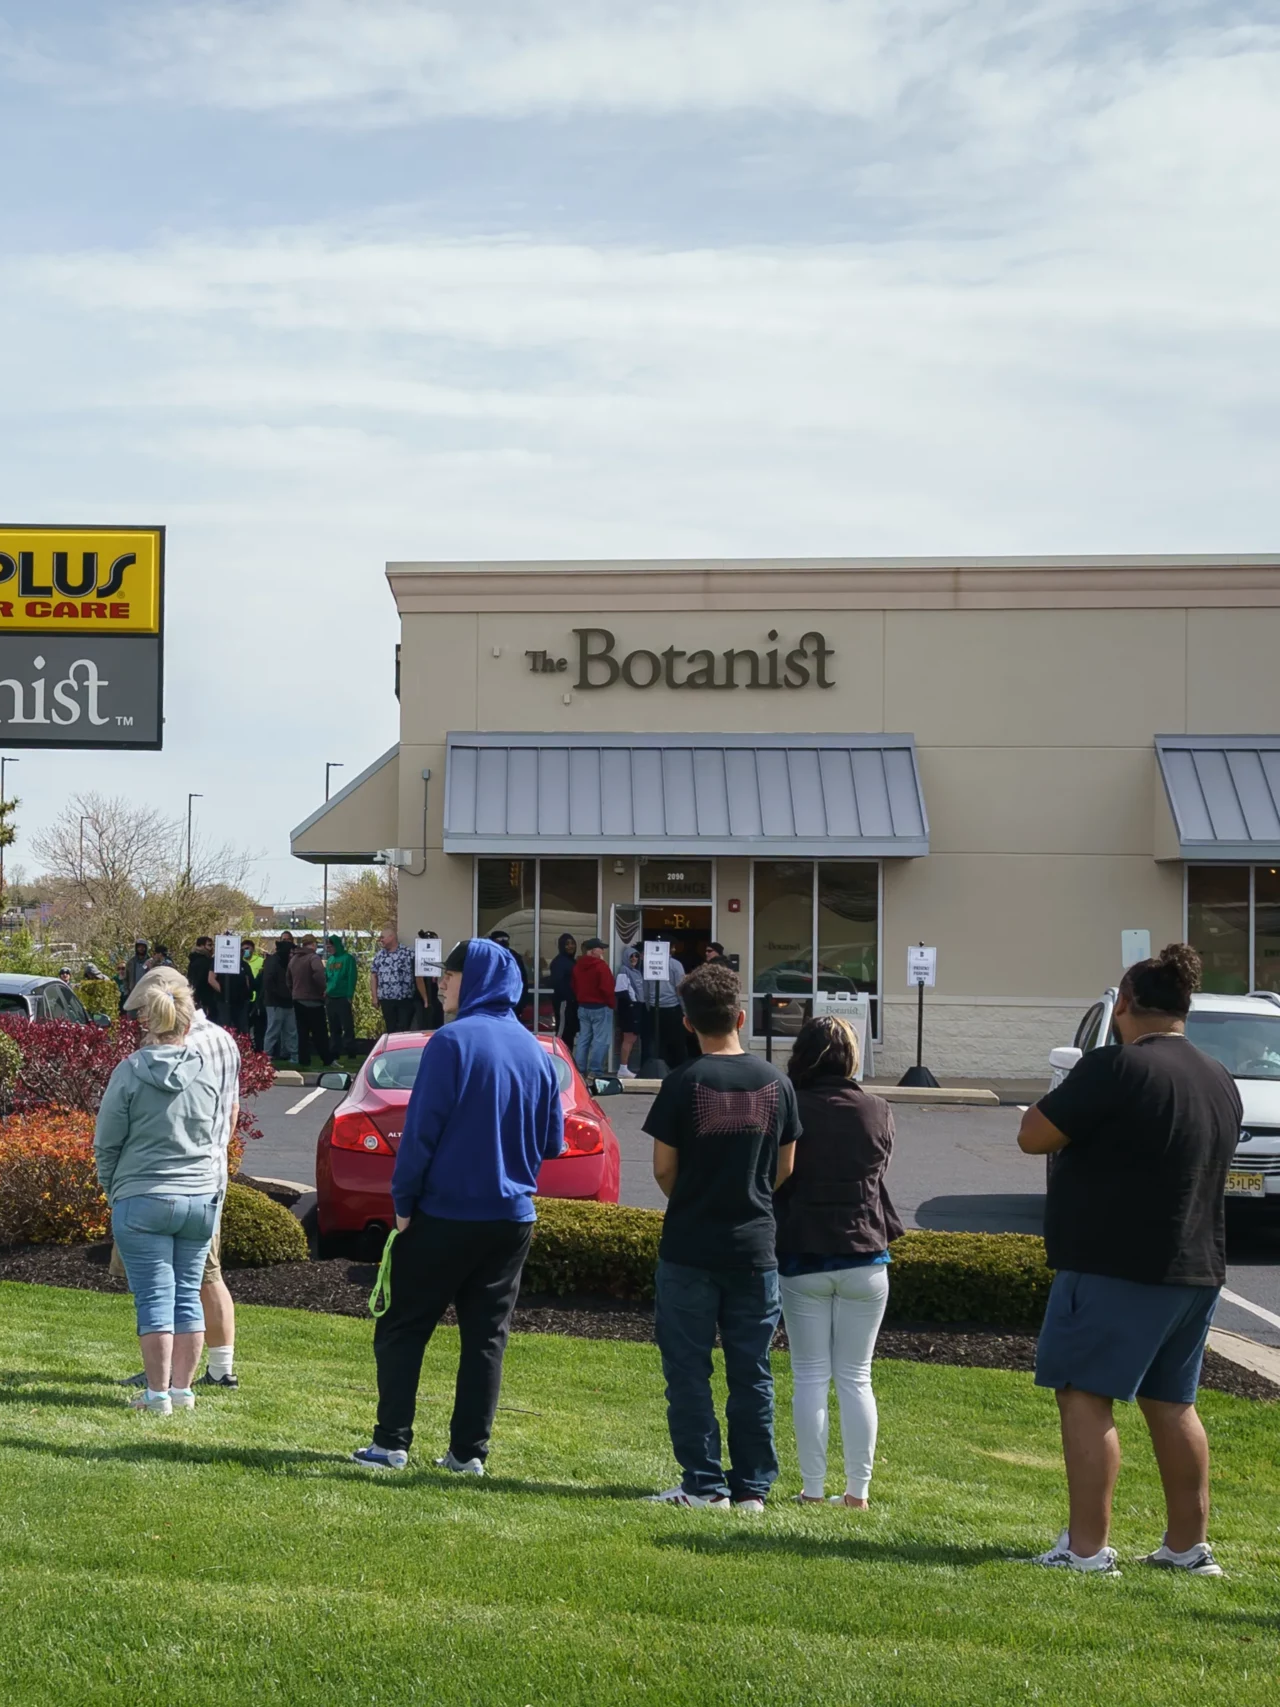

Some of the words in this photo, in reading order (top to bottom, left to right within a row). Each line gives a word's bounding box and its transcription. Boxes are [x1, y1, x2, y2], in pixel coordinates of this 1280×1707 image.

[25, 602, 130, 619] CARE
[524, 650, 568, 673] The
[572, 628, 836, 689] Botanist
[667, 873, 685, 881] 2090
[644, 882, 708, 894] ENTRANCE
[826, 1005, 859, 1015] Botanist
